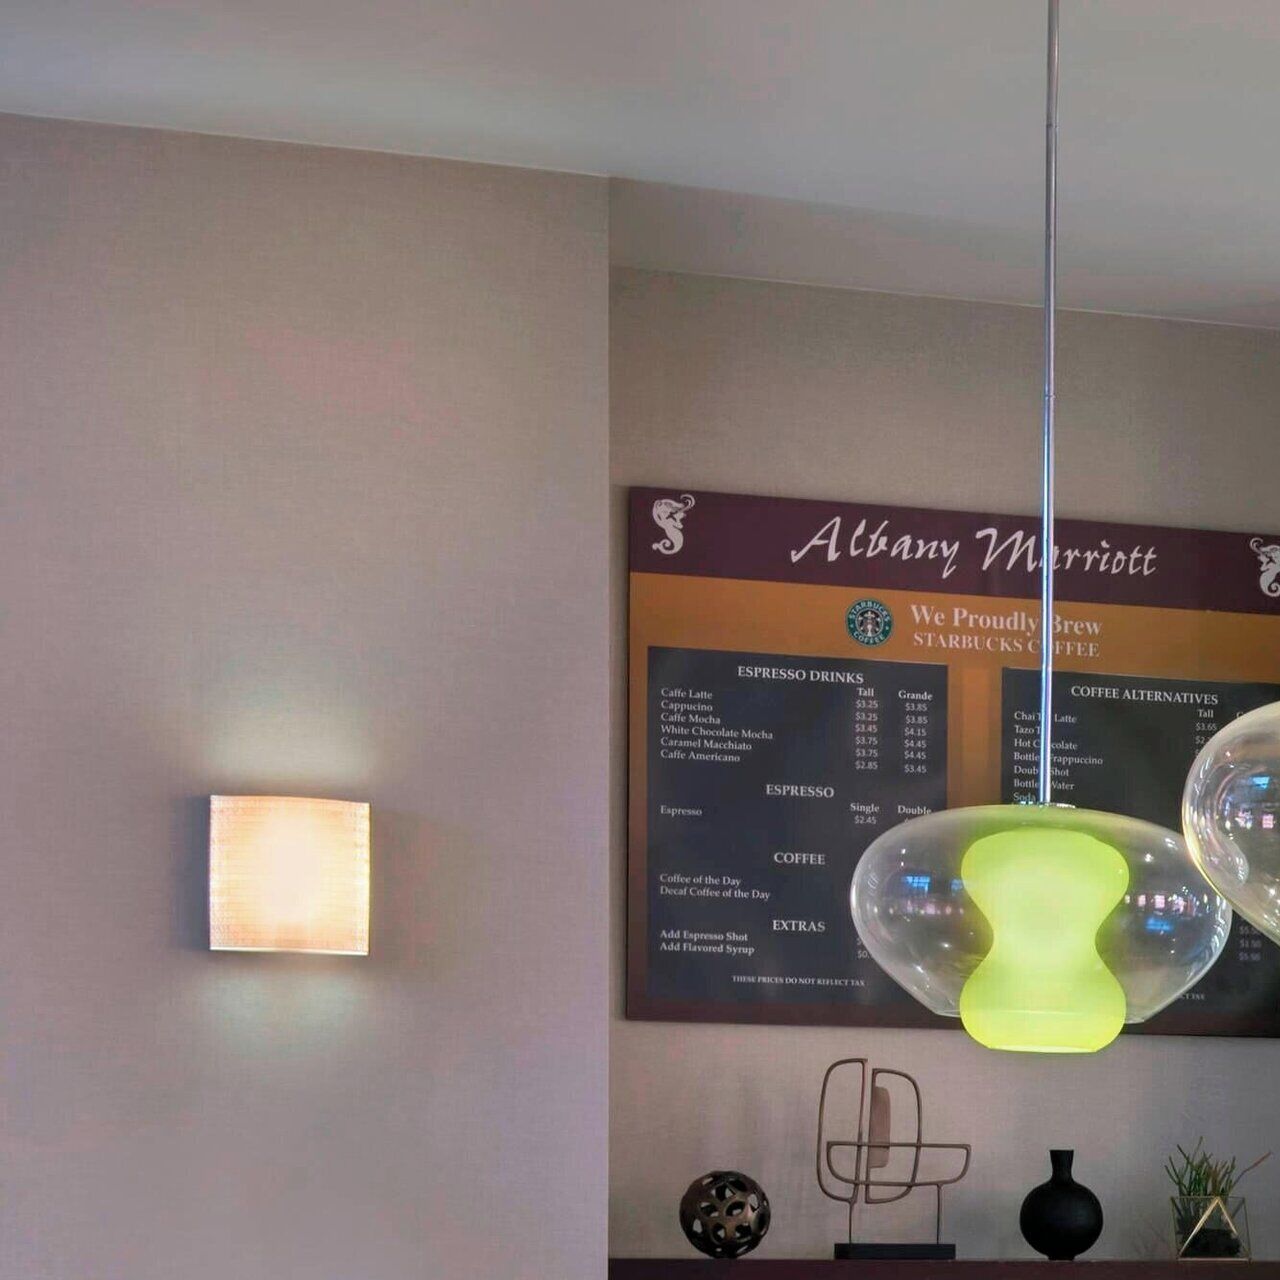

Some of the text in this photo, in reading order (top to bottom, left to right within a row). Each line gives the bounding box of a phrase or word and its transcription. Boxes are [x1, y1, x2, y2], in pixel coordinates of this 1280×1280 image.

[791, 516, 960, 578] Albany
[911, 604, 945, 626] We
[952, 607, 1040, 637] Proudly
[914, 631, 1023, 653] STARBUCKS
[737, 665, 864, 684] ESPRESSO DRINKS
[661, 687, 713, 700] Caffe Latte
[856, 687, 875, 698] Tall
[898, 690, 933, 702] Grande
[1071, 685, 1218, 706] COFFEE ALTERNATIVES
[661, 712, 721, 725] Caffe Mocha
[1014, 711, 1035, 721] Chai
[1054, 713, 1078, 724] Latte
[1197, 708, 1214, 719] Tall
[661, 725, 773, 740] White Chocolate Mocha
[1014, 724, 1035, 735] Tazo
[661, 737, 752, 751] Caramel Macchiato
[1014, 738, 1078, 751] Hot Ccolate
[661, 749, 741, 763] Caffe Americano
[1014, 752, 1043, 762] Bottle
[1013, 778, 1042, 789] Bottle
[766, 784, 834, 799] ESPRESSO
[1013, 792, 1037, 802] Soda
[660, 805, 702, 817] Espresso
[850, 802, 932, 816] Single Double
[774, 851, 826, 866] COFFEE
[659, 873, 741, 887] Coffee of the Day
[660, 885, 771, 901] Decaf Coffee of the Day
[772, 919, 826, 933] EXTRAS
[660, 930, 748, 943] Add Espresso Shot
[660, 942, 755, 956] Add Flavored Syrup
[785, 977, 798, 985] DO
[799, 978, 816, 986] NOT
